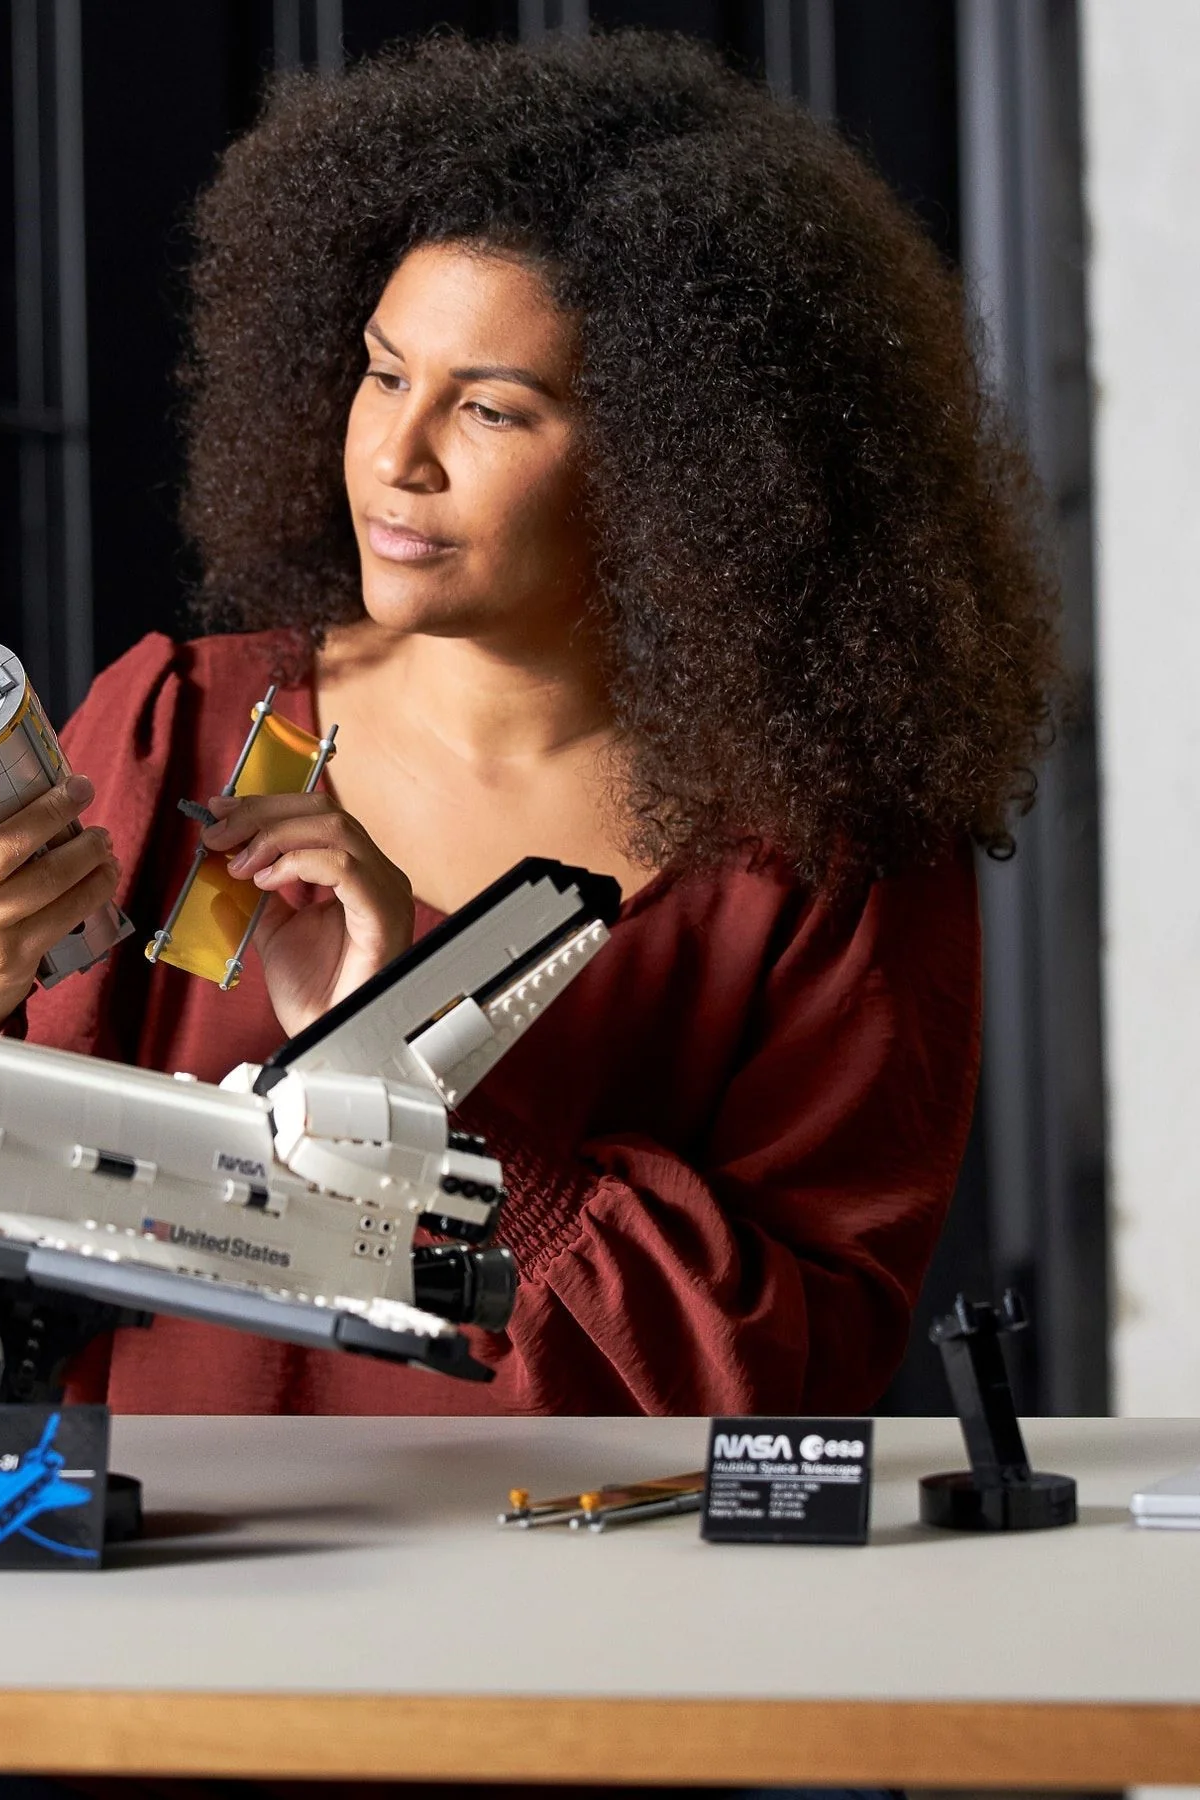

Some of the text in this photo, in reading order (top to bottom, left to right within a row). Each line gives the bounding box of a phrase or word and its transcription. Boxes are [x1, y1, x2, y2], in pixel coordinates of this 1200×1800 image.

[217, 1153, 266, 1178] NASA
[169, 1224, 291, 1268] United States
[714, 1434, 793, 1460] NASA
